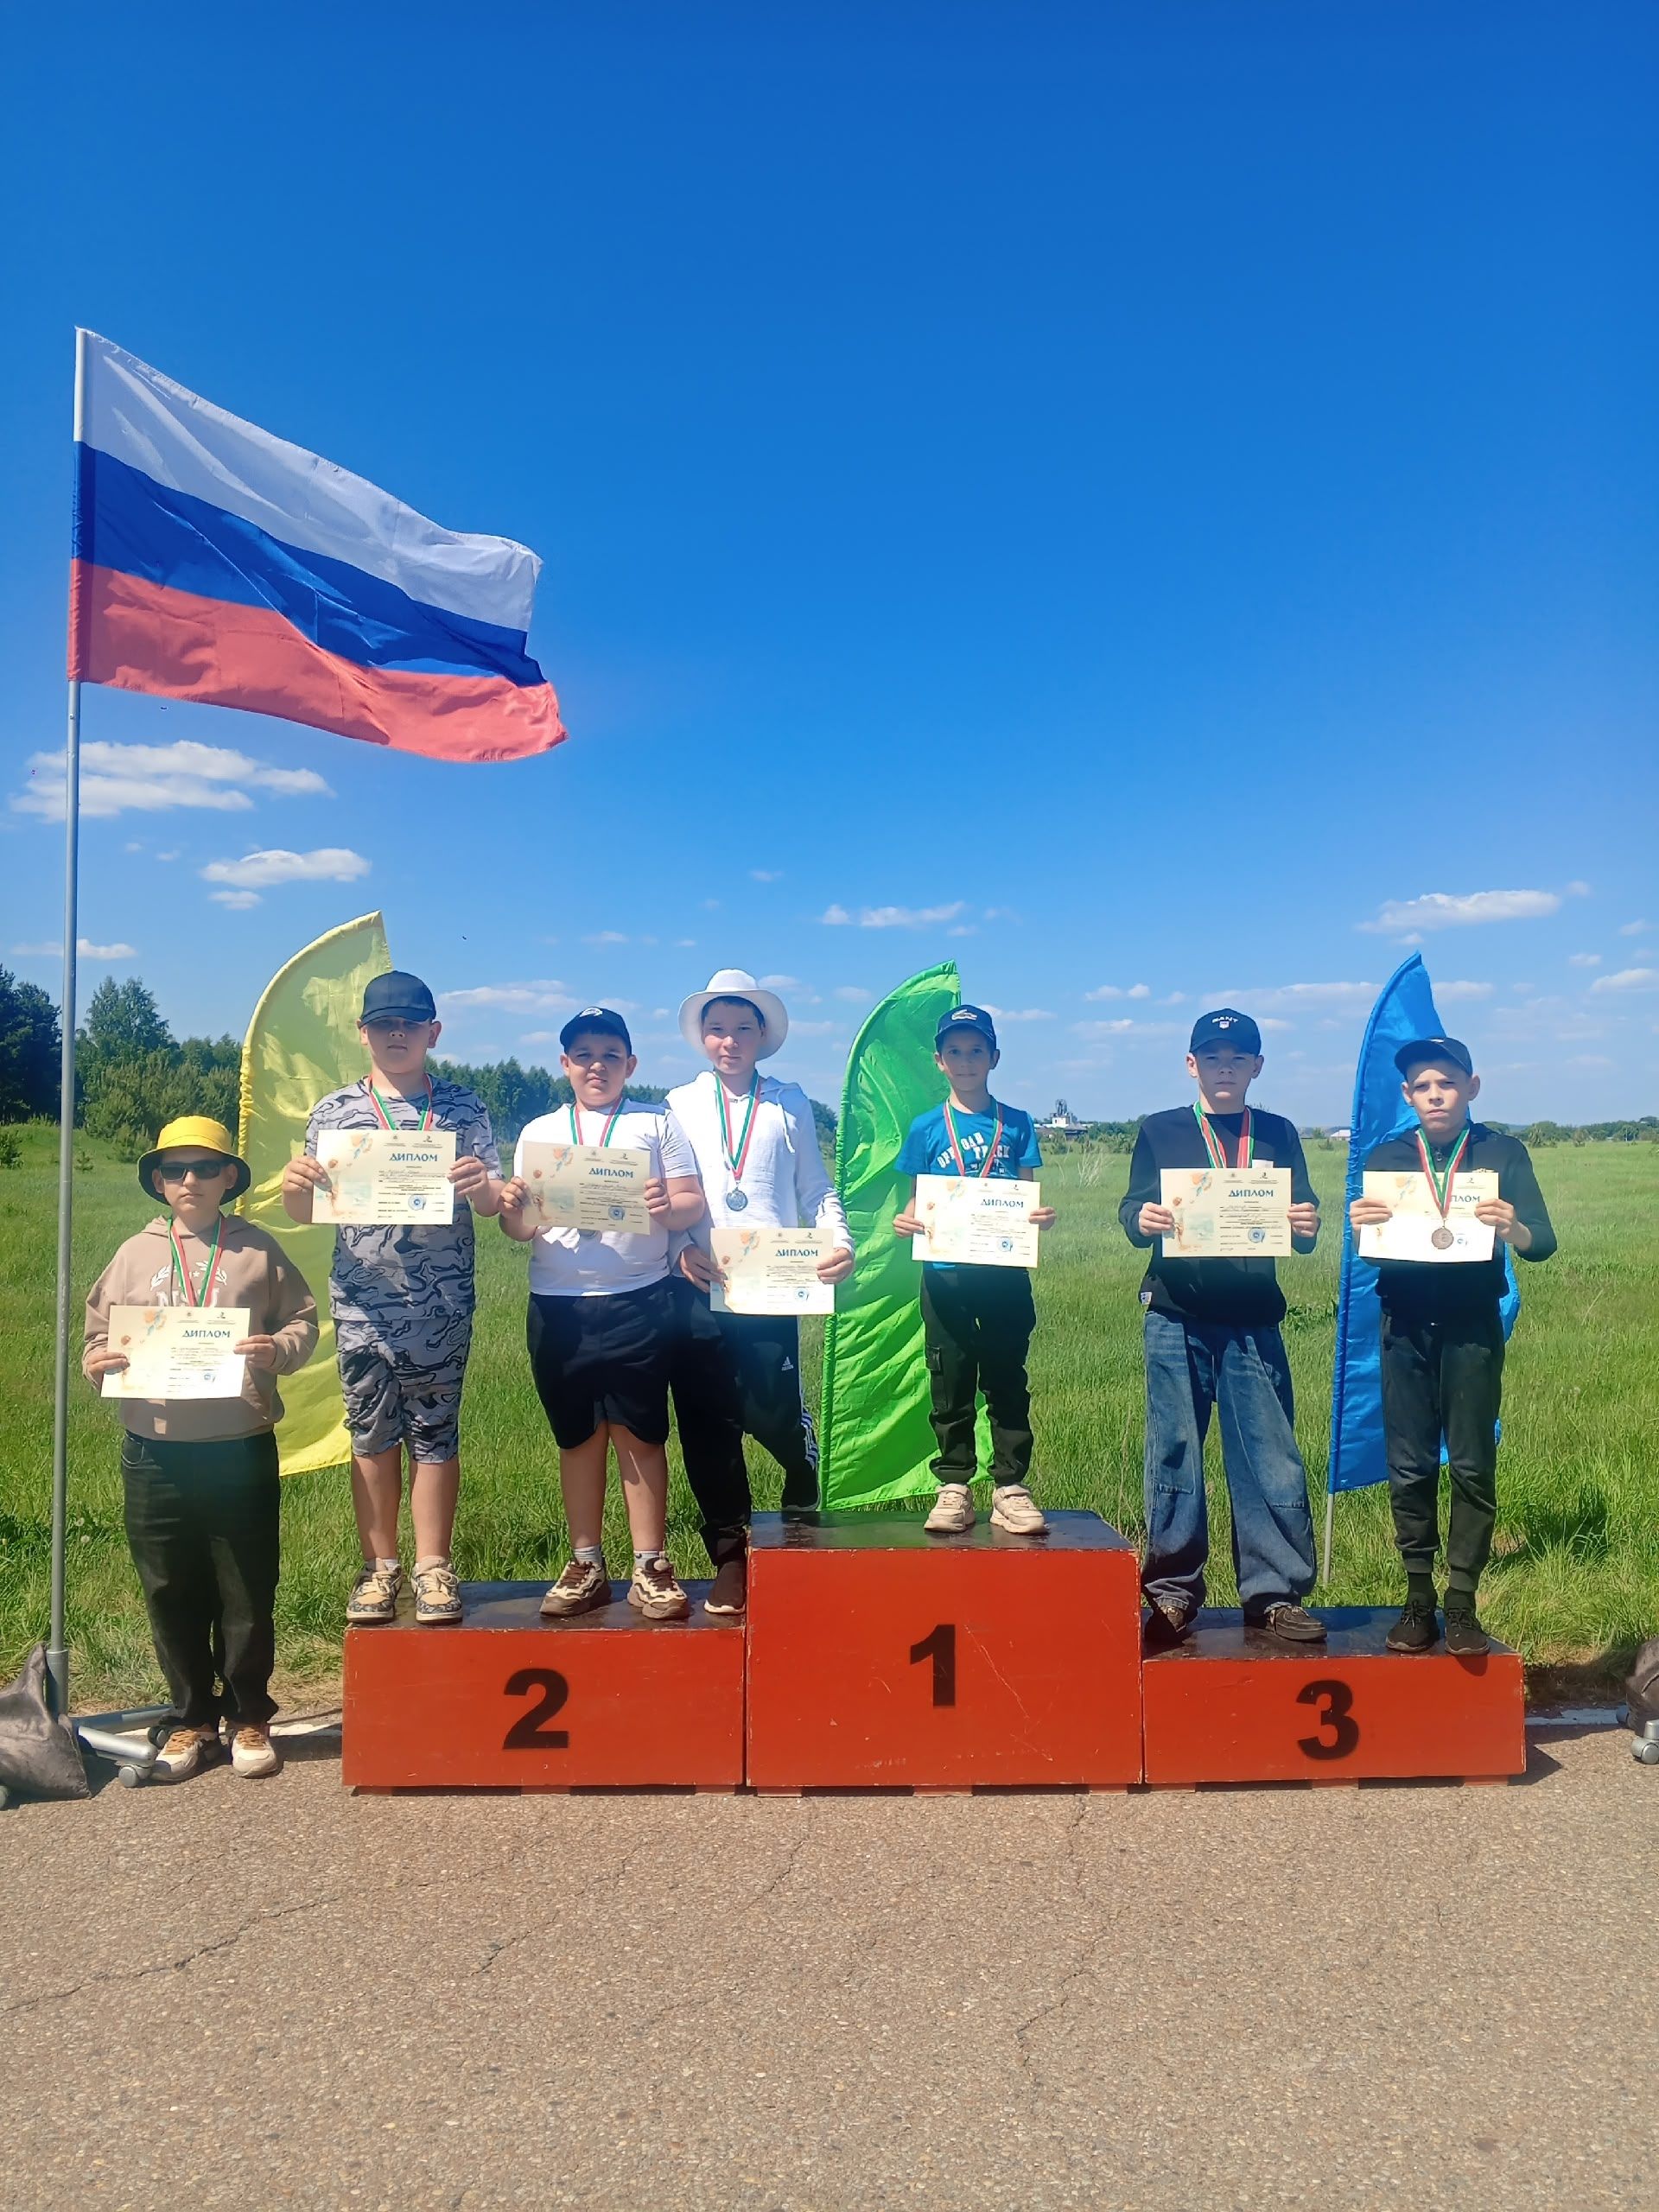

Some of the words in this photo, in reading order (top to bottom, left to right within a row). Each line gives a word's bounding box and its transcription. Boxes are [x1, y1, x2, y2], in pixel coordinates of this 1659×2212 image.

[390, 1154, 438, 1162] ДИПЛОМ
[973, 1145, 1010, 1160] TRCK
[588, 1167, 633, 1178] ДИПЛОМ
[980, 1198, 1024, 1208] ДИПЛОМ
[910, 1624, 956, 1709] 1
[502, 1668, 569, 1750] 2
[1296, 1679, 1360, 1761] 3
